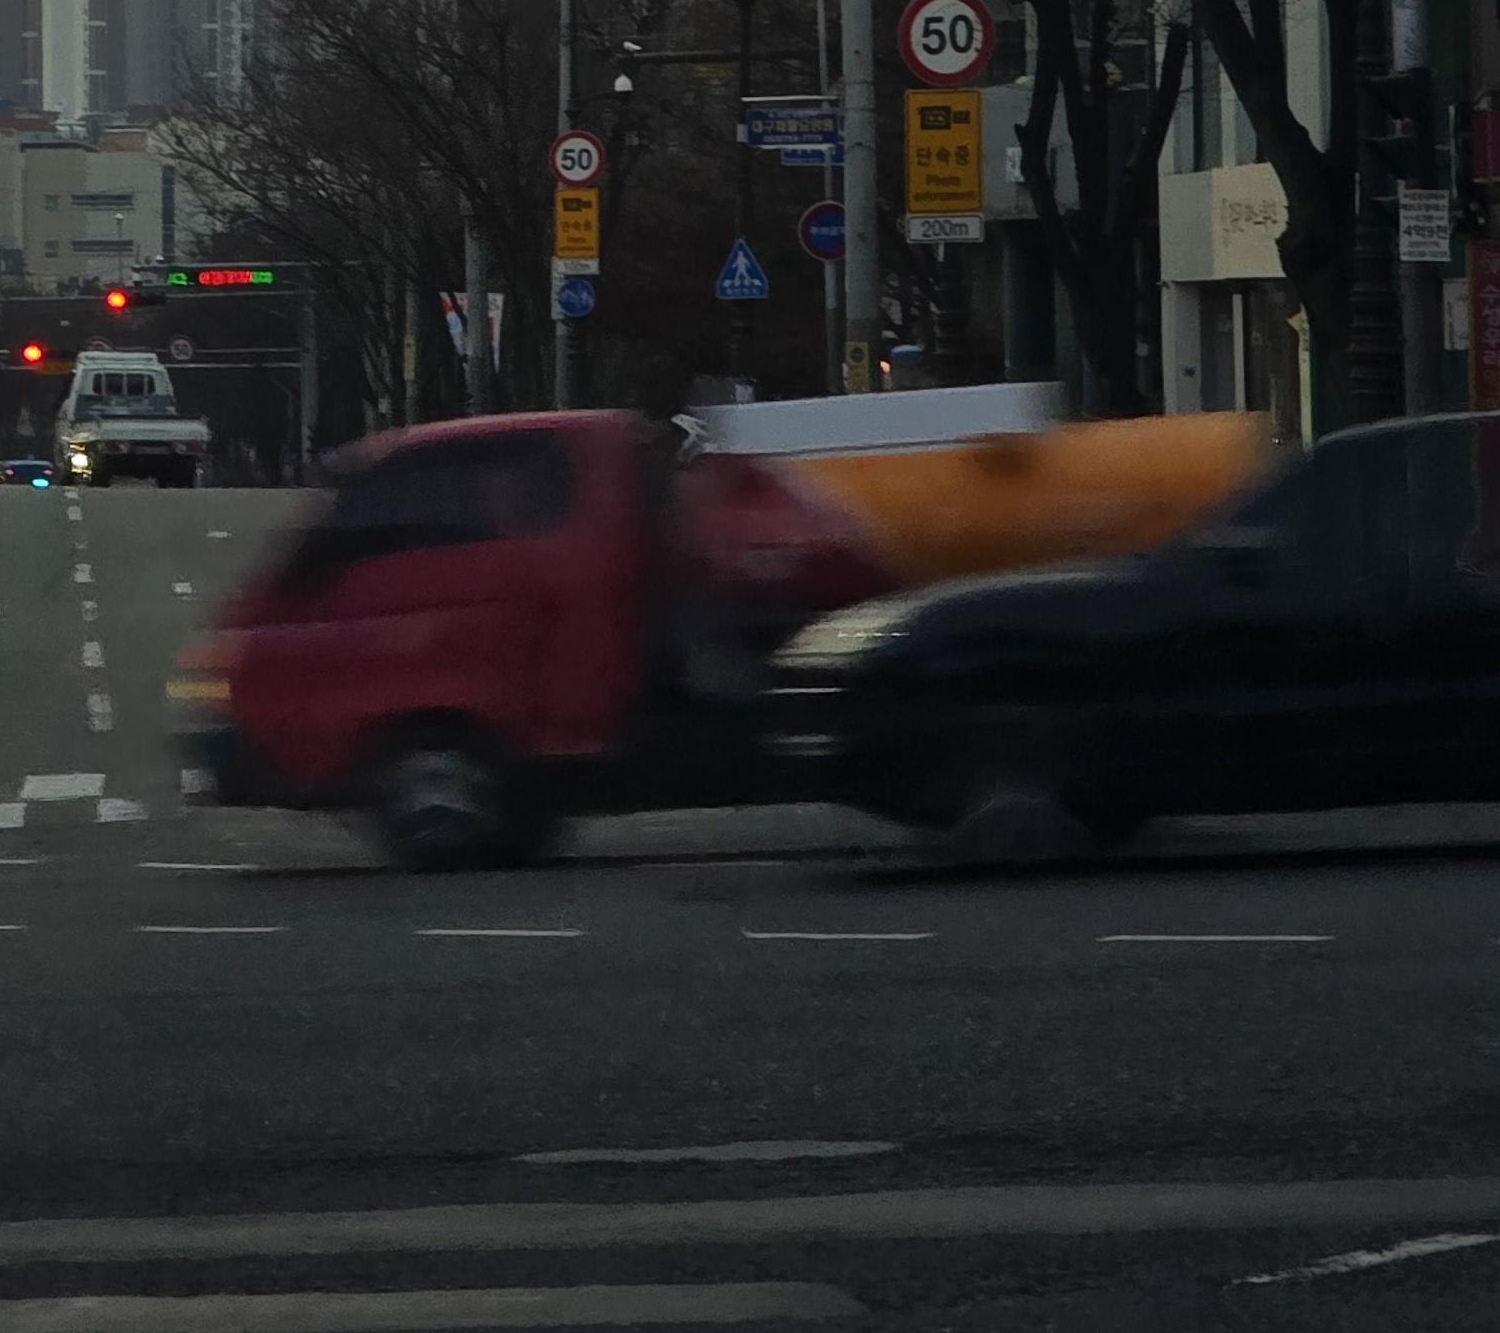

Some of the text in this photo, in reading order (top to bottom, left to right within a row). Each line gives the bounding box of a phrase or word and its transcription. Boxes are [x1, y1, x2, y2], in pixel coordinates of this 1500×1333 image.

[921, 13, 975, 56] 50
[560, 147, 593, 172] 50
[920, 219, 970, 239] 200m
